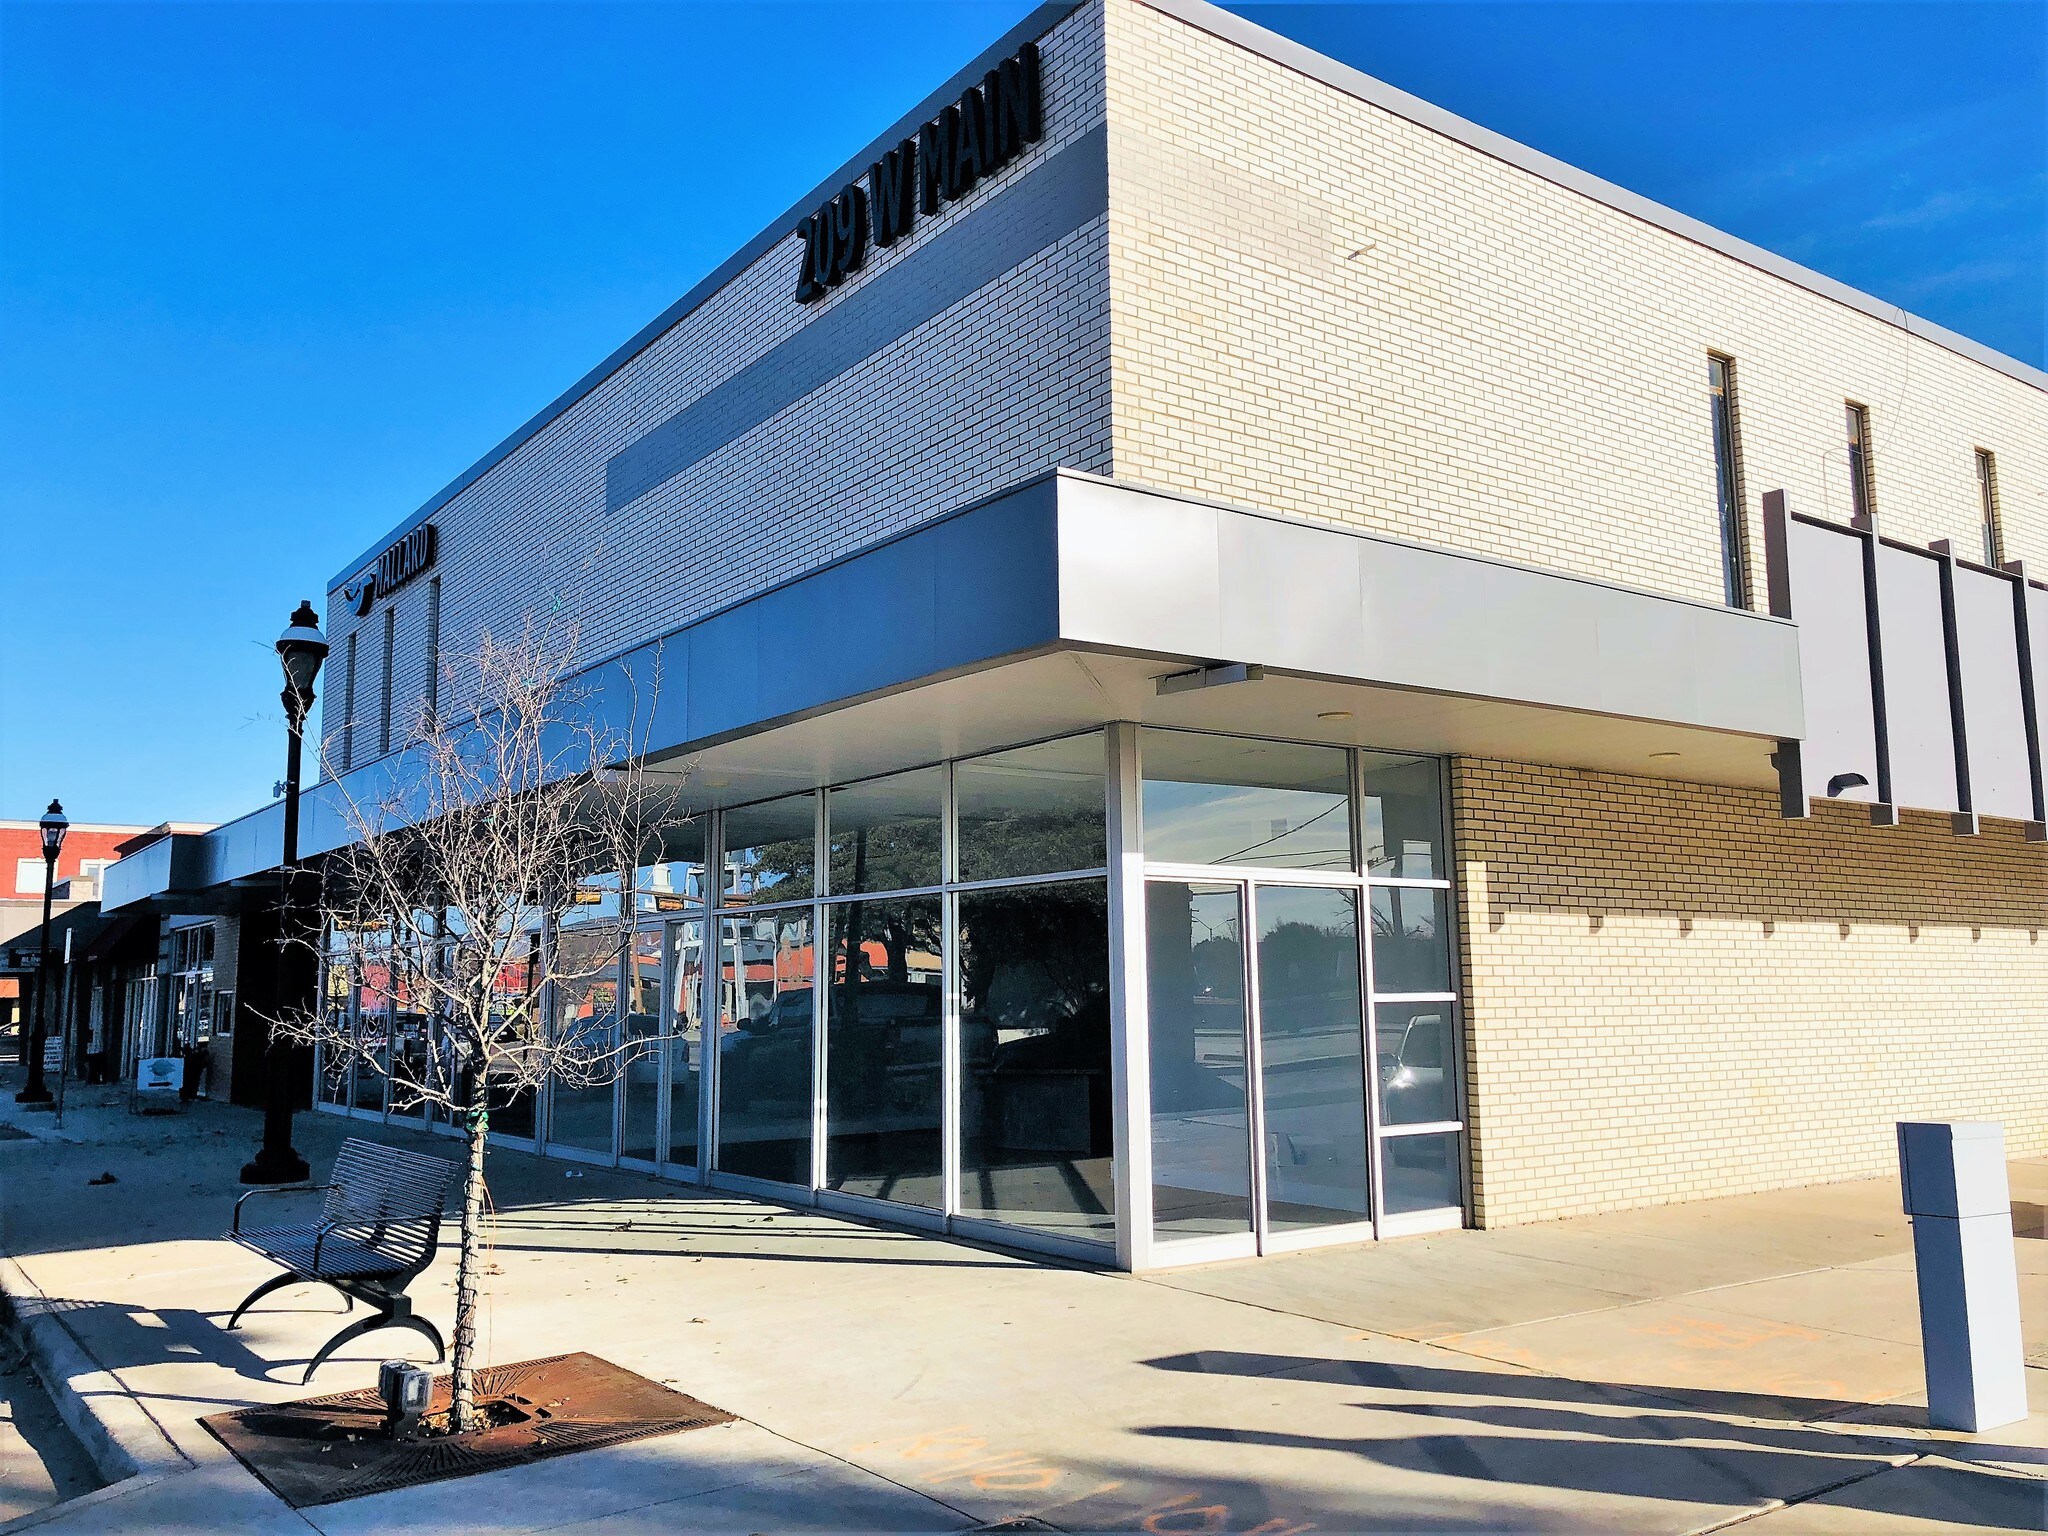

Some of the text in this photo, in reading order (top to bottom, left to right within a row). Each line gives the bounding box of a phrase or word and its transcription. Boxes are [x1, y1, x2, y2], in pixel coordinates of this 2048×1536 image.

[795, 41, 1042, 304] 209 W MAIN
[374, 523, 436, 600] MALLARD
